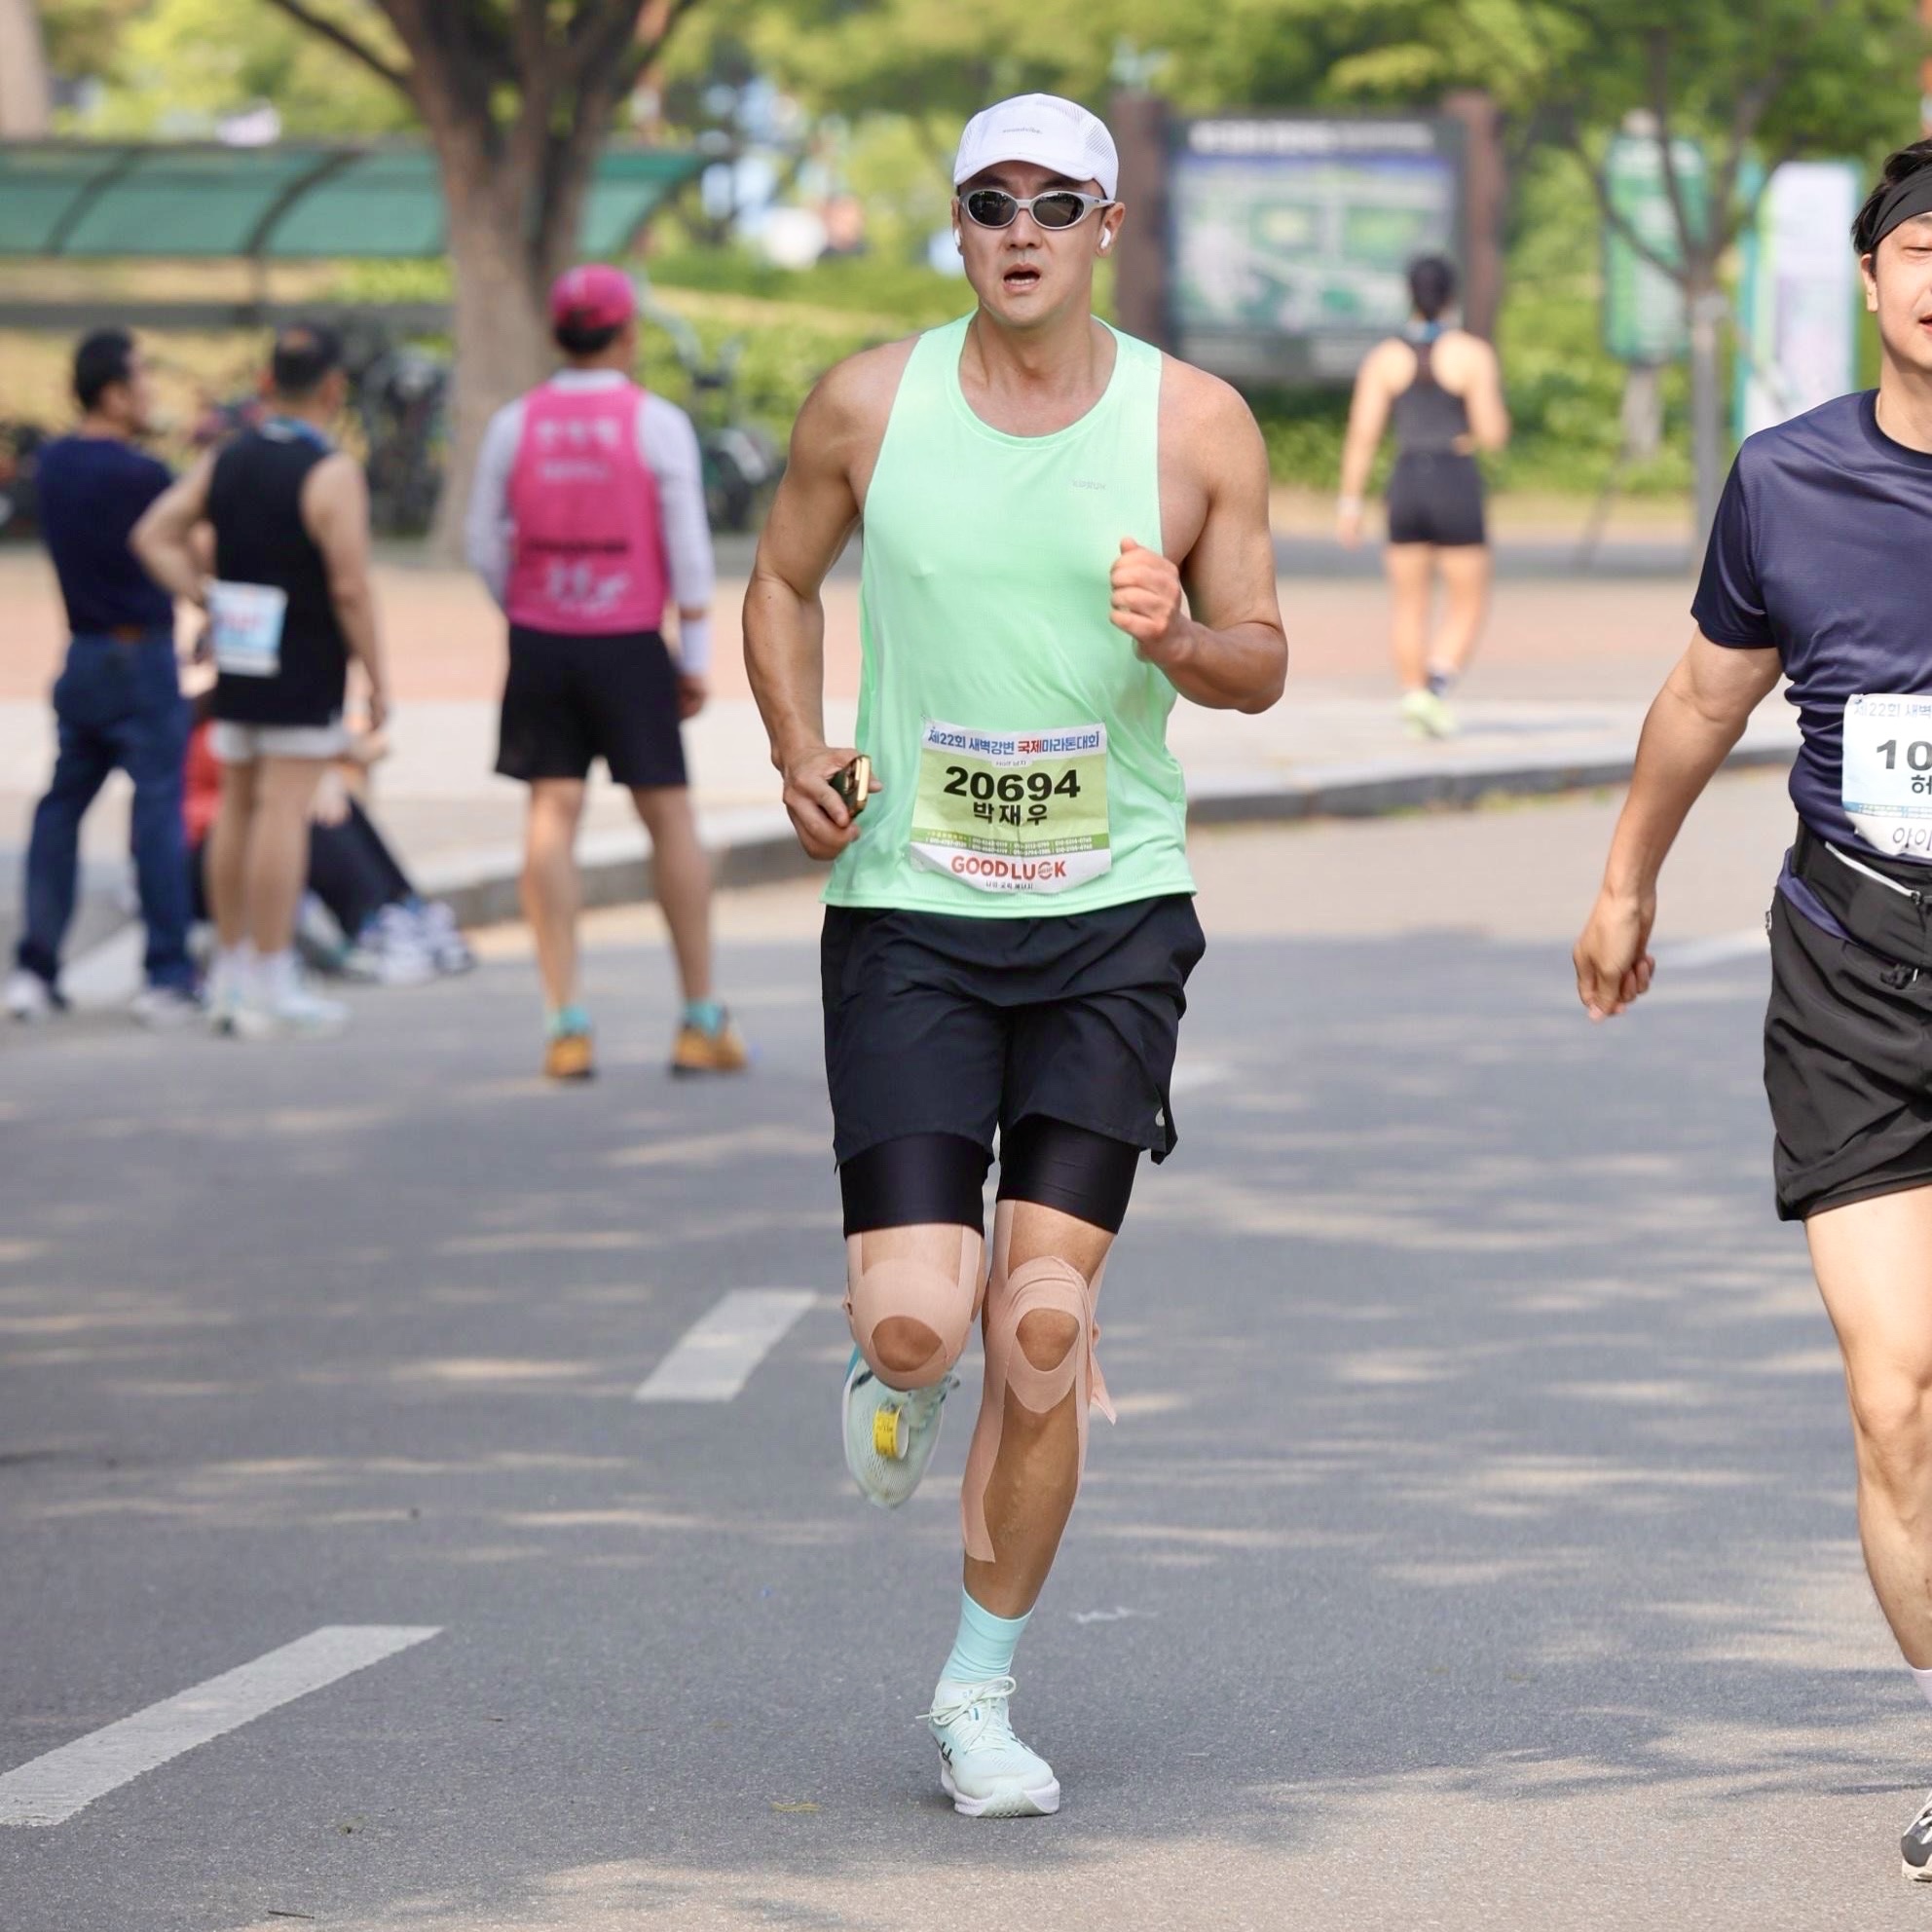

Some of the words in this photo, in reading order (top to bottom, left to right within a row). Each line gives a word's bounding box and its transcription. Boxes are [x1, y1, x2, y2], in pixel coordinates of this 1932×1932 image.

[1854, 700, 1900, 717] 제22회
[928, 729, 966, 749] 제22회
[969, 737, 1015, 755] 새벽강변
[1018, 732, 1099, 754] 국제마라톤대회
[944, 765, 1081, 801] 20694
